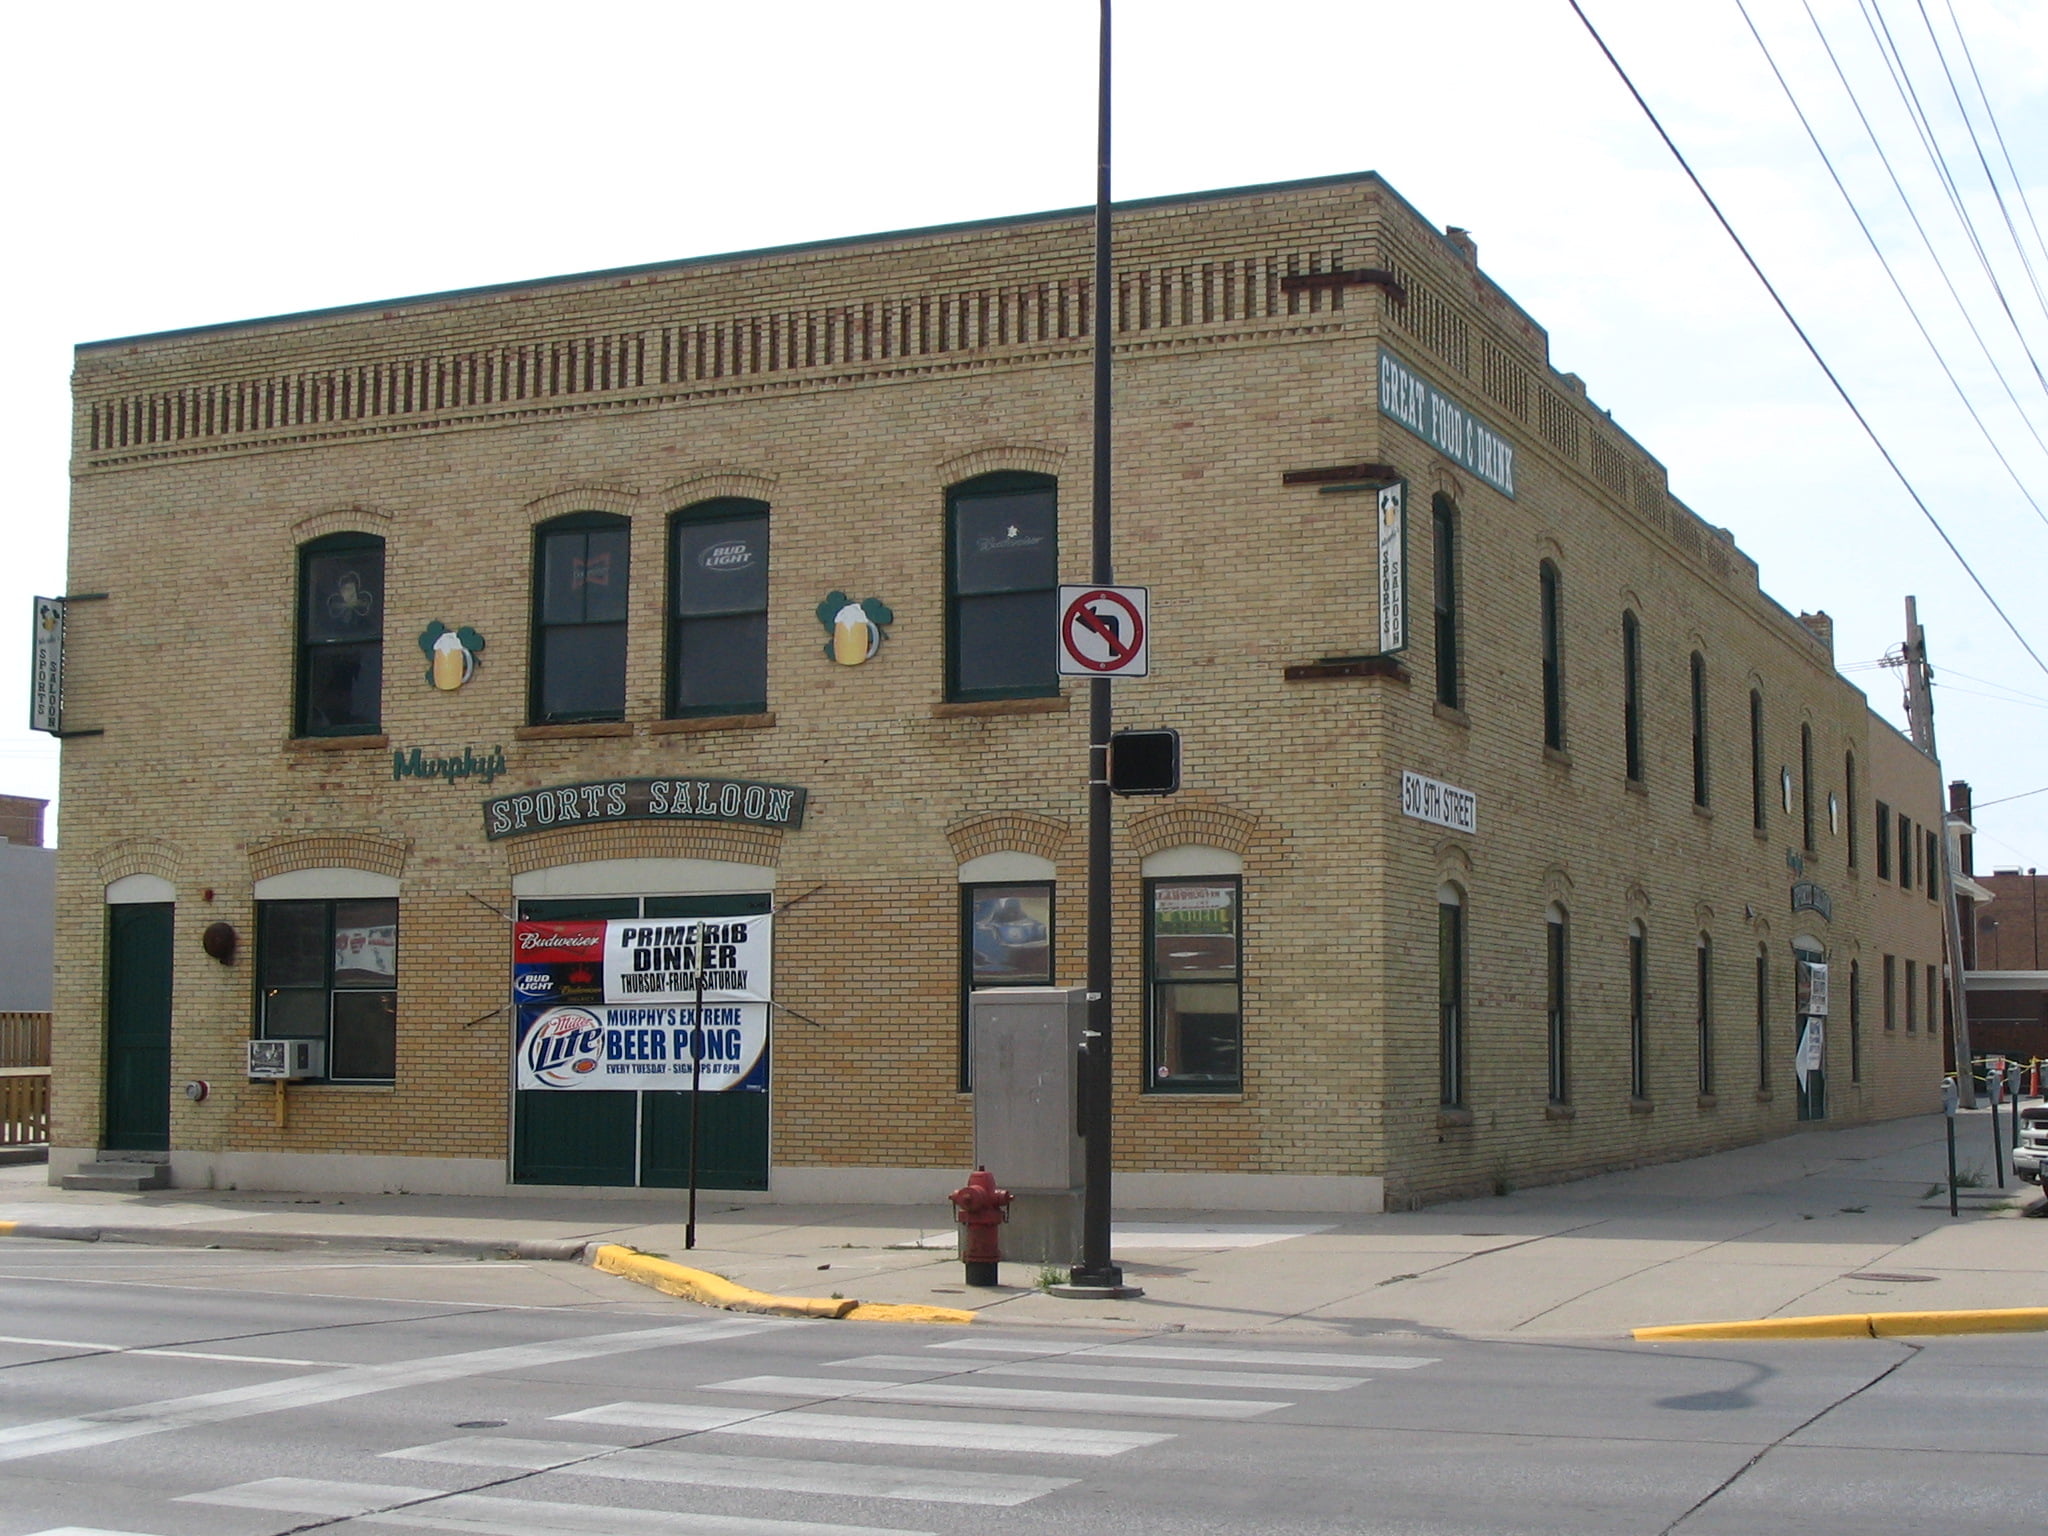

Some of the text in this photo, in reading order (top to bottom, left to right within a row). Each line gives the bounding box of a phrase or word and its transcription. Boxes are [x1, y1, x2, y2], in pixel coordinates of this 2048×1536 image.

[1381, 355, 1425, 434] GREAT
[1431, 391, 1463, 460] FOOD
[1477, 425, 1514, 495] DRINK
[705, 553, 752, 567] LIGHT
[712, 545, 747, 556] BUD
[1382, 551, 1391, 634] SPORTS
[1391, 562, 1400, 645] SALOON
[38, 648, 47, 715] SPORTS
[48, 661, 57, 728] SALOON
[392, 744, 506, 786] Murphy's
[492, 781, 794, 834] SPORTS SALOON
[1405, 775, 1474, 829] 510 9TH STREET
[518, 932, 600, 949] Budweiser
[621, 923, 748, 948] PRIME RIB
[633, 945, 737, 972] DINNER
[520, 982, 554, 990] LIGHT
[524, 974, 550, 983] BUD
[549, 1016, 593, 1035] Miller
[607, 1008, 676, 1026] MURPHY'S
[533, 1027, 602, 1073] Lite
[606, 1029, 741, 1060] BEER PONG
[606, 1064, 630, 1074] EVERY
[632, 1064, 667, 1074] TUESDAY
[713, 1063, 722, 1074] AT
[723, 1063, 740, 1074] 8PM
